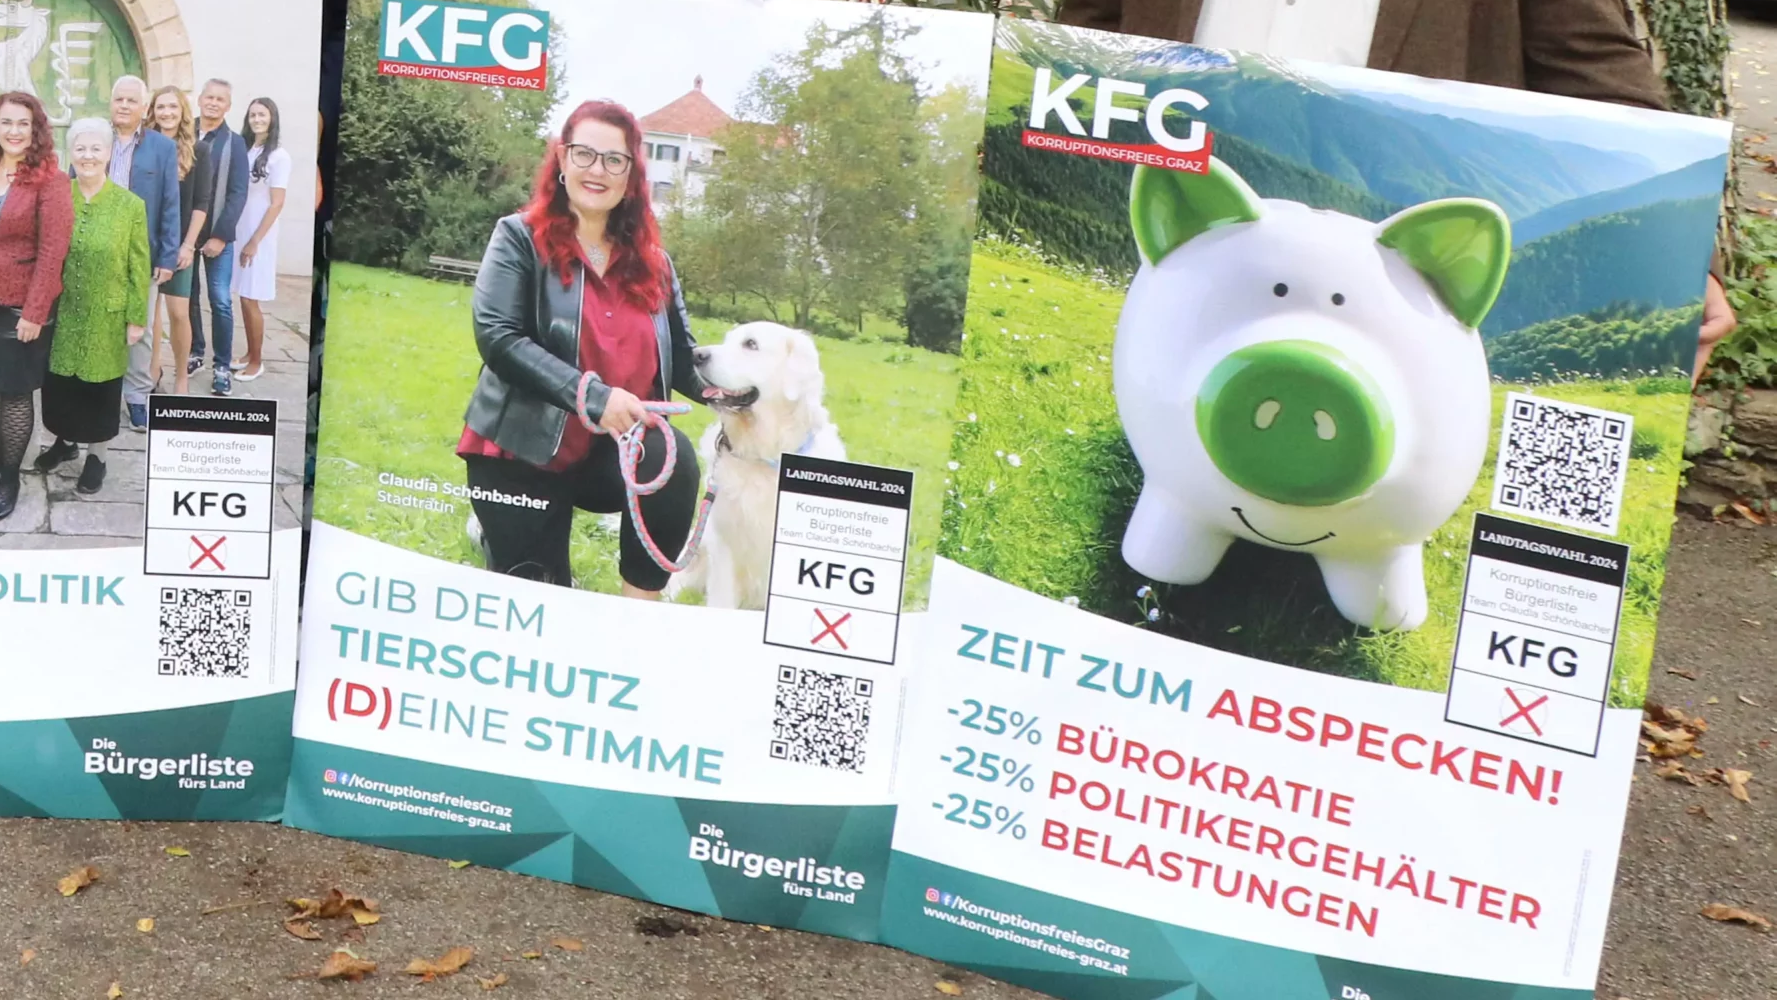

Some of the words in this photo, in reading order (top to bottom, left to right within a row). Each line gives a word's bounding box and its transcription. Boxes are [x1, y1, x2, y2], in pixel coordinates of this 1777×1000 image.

[384, 2, 543, 71] KFG
[382, 62, 506, 86] KORRUPTIONSFREIES
[507, 76, 540, 90] GRAZ
[1028, 66, 1210, 154] KFG
[1027, 134, 1164, 166] KORRUPTIONSFREIES
[1165, 156, 1203, 173] GRAZ
[155, 408, 244, 422] LANDTAGSWAHL
[246, 411, 270, 423] 2024
[166, 438, 256, 454] Korruptionsfreie
[180, 452, 241, 467] Bürgerliste
[152, 463, 175, 474] Team
[178, 464, 209, 475] Claudia
[212, 465, 270, 477] Schönbacher
[786, 468, 880, 491] LANDTAGSWAHL
[881, 482, 905, 495] 2024
[172, 490, 247, 519] KFG
[377, 489, 455, 514] Stadträtin
[378, 472, 439, 492] Claudia
[442, 480, 550, 513] Schönbacher
[796, 500, 889, 527] Korruptionsfreie
[809, 518, 872, 539] Bürgerliste
[779, 527, 803, 539] Team
[806, 531, 838, 544] Claudia
[840, 535, 901, 555] Schönbacher
[1480, 529, 1588, 564] LANDTAGSWAHL
[1589, 554, 1620, 571] 2024
[796, 557, 876, 596] KFG
[1489, 567, 1598, 604] Korruptionsfreie
[335, 570, 418, 614] GIB
[435, 586, 545, 638] DEM
[1469, 594, 1496, 610] Team
[1498, 600, 1537, 621] Claudia
[1539, 608, 1611, 638] Schönbacher
[1504, 587, 1578, 617] Bürgerliste
[330, 624, 640, 712] TIERSCHUTZ
[1488, 630, 1579, 680] KFG
[326, 677, 508, 745] (D)EINE
[524, 717, 725, 786] STIMME
[956, 623, 1064, 678] ZEIT
[1077, 653, 1193, 713] ZUM
[1207, 688, 1564, 805] ABSPECKEN!
[92, 737, 117, 751] Die
[946, 700, 1042, 745] -25%
[1057, 721, 1355, 827] BÜROKRATIE
[84, 752, 254, 780] Bürgerliste
[178, 776, 206, 790] fürs
[210, 776, 245, 790] Land
[322, 787, 512, 833] www.korruptionsfreies-graz.at
[349, 772, 513, 820] /KorruptionsfreiesGraz
[699, 823, 724, 839] Die
[939, 748, 1035, 794] -25%
[1049, 770, 1542, 929] POLITIKERGEHÄLTER
[689, 835, 865, 890] Bürgerliste
[931, 794, 1027, 841] -25%
[1041, 818, 1379, 937] BELASTUNGEN
[782, 882, 811, 899] fürs
[816, 886, 855, 904] Land
[923, 905, 1129, 976] www.korruptionsfreies-graz.at
[953, 895, 1131, 959] /KorruptionsfreiesGraz
